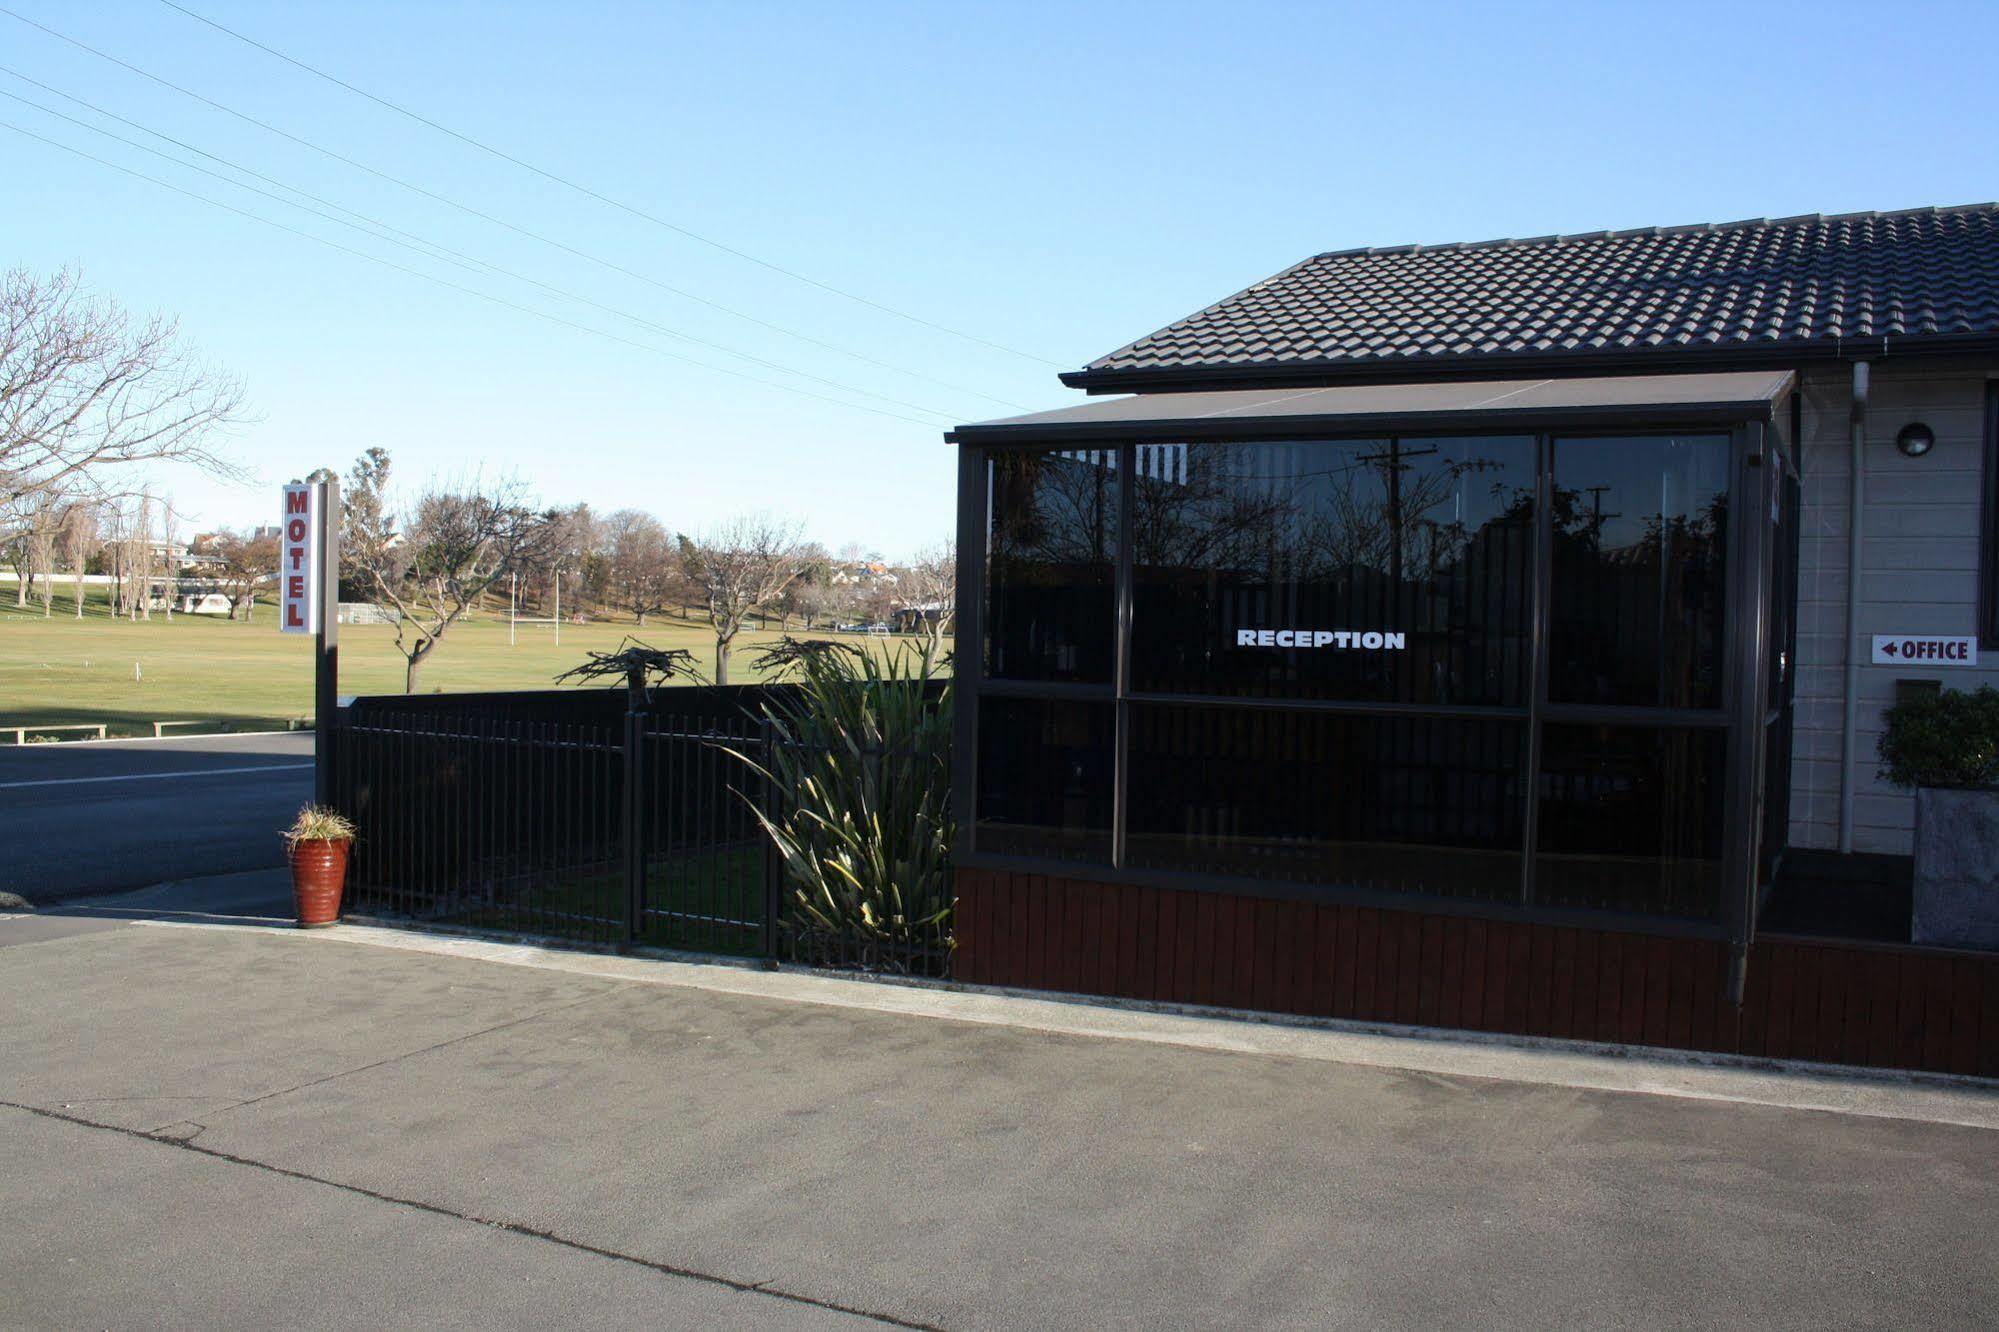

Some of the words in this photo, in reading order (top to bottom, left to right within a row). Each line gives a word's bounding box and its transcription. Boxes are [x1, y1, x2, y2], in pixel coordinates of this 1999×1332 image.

[286, 491, 308, 627] MOTEL
[1237, 629, 1405, 650] RECEPTION
[1902, 641, 1968, 660] OFFICE
